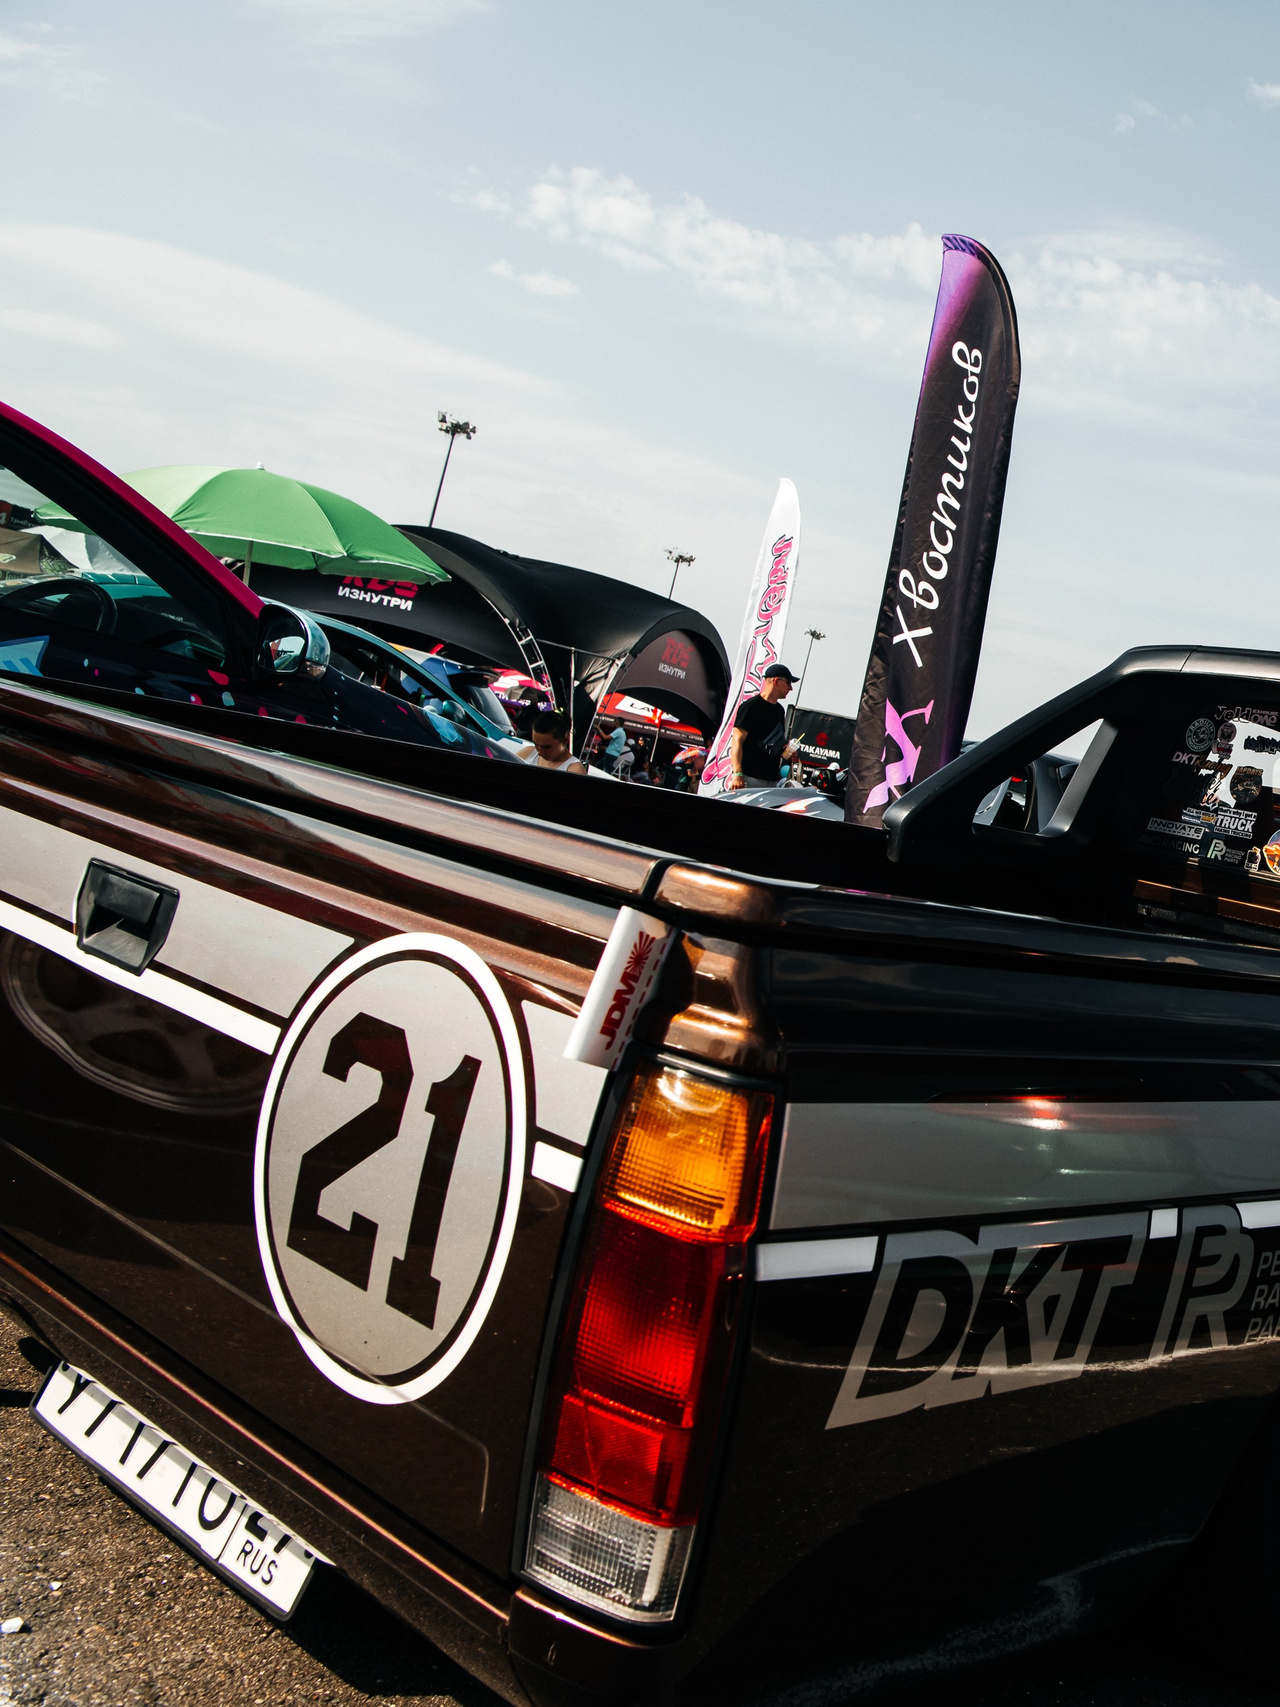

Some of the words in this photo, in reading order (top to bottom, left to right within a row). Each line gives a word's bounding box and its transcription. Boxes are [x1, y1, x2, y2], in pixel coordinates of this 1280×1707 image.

[338, 586, 413, 611] ИЗНУТРИ
[662, 637, 695, 669] RDS
[658, 663, 686, 679] ИЗНУТРИ
[799, 744, 840, 760] TAKAYAMA
[1172, 751, 1200, 766] DKT
[1150, 818, 1203, 835] INNOVATE
[1216, 814, 1255, 833] TRUCK
[600, 972, 640, 1050] JDM
[285, 1011, 482, 1330] 21
[838, 1218, 1144, 1416] DKT
[236, 1539, 278, 1585] RUS
